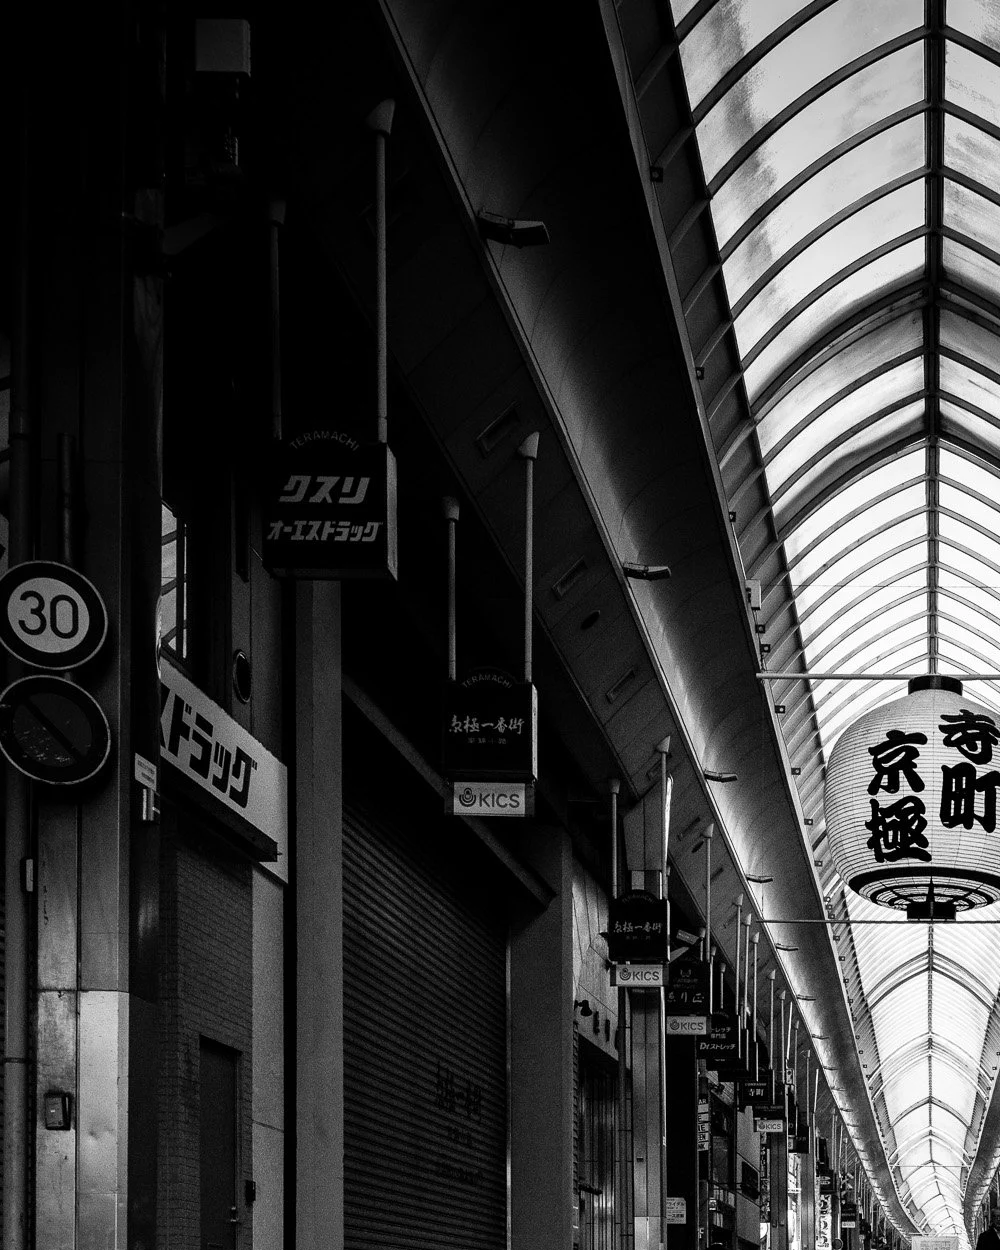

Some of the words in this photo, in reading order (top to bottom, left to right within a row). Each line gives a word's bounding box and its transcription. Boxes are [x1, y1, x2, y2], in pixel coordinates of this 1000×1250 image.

[289, 429, 360, 452] TERAMACHI
[278, 474, 371, 504] クスリ
[266, 519, 384, 542] オーエスドラッグ
[18, 590, 79, 639] 30
[479, 793, 521, 809] KICS
[865, 730, 932, 863] 京極
[632, 971, 660, 982] KICS
[680, 1022, 704, 1031] KICS
